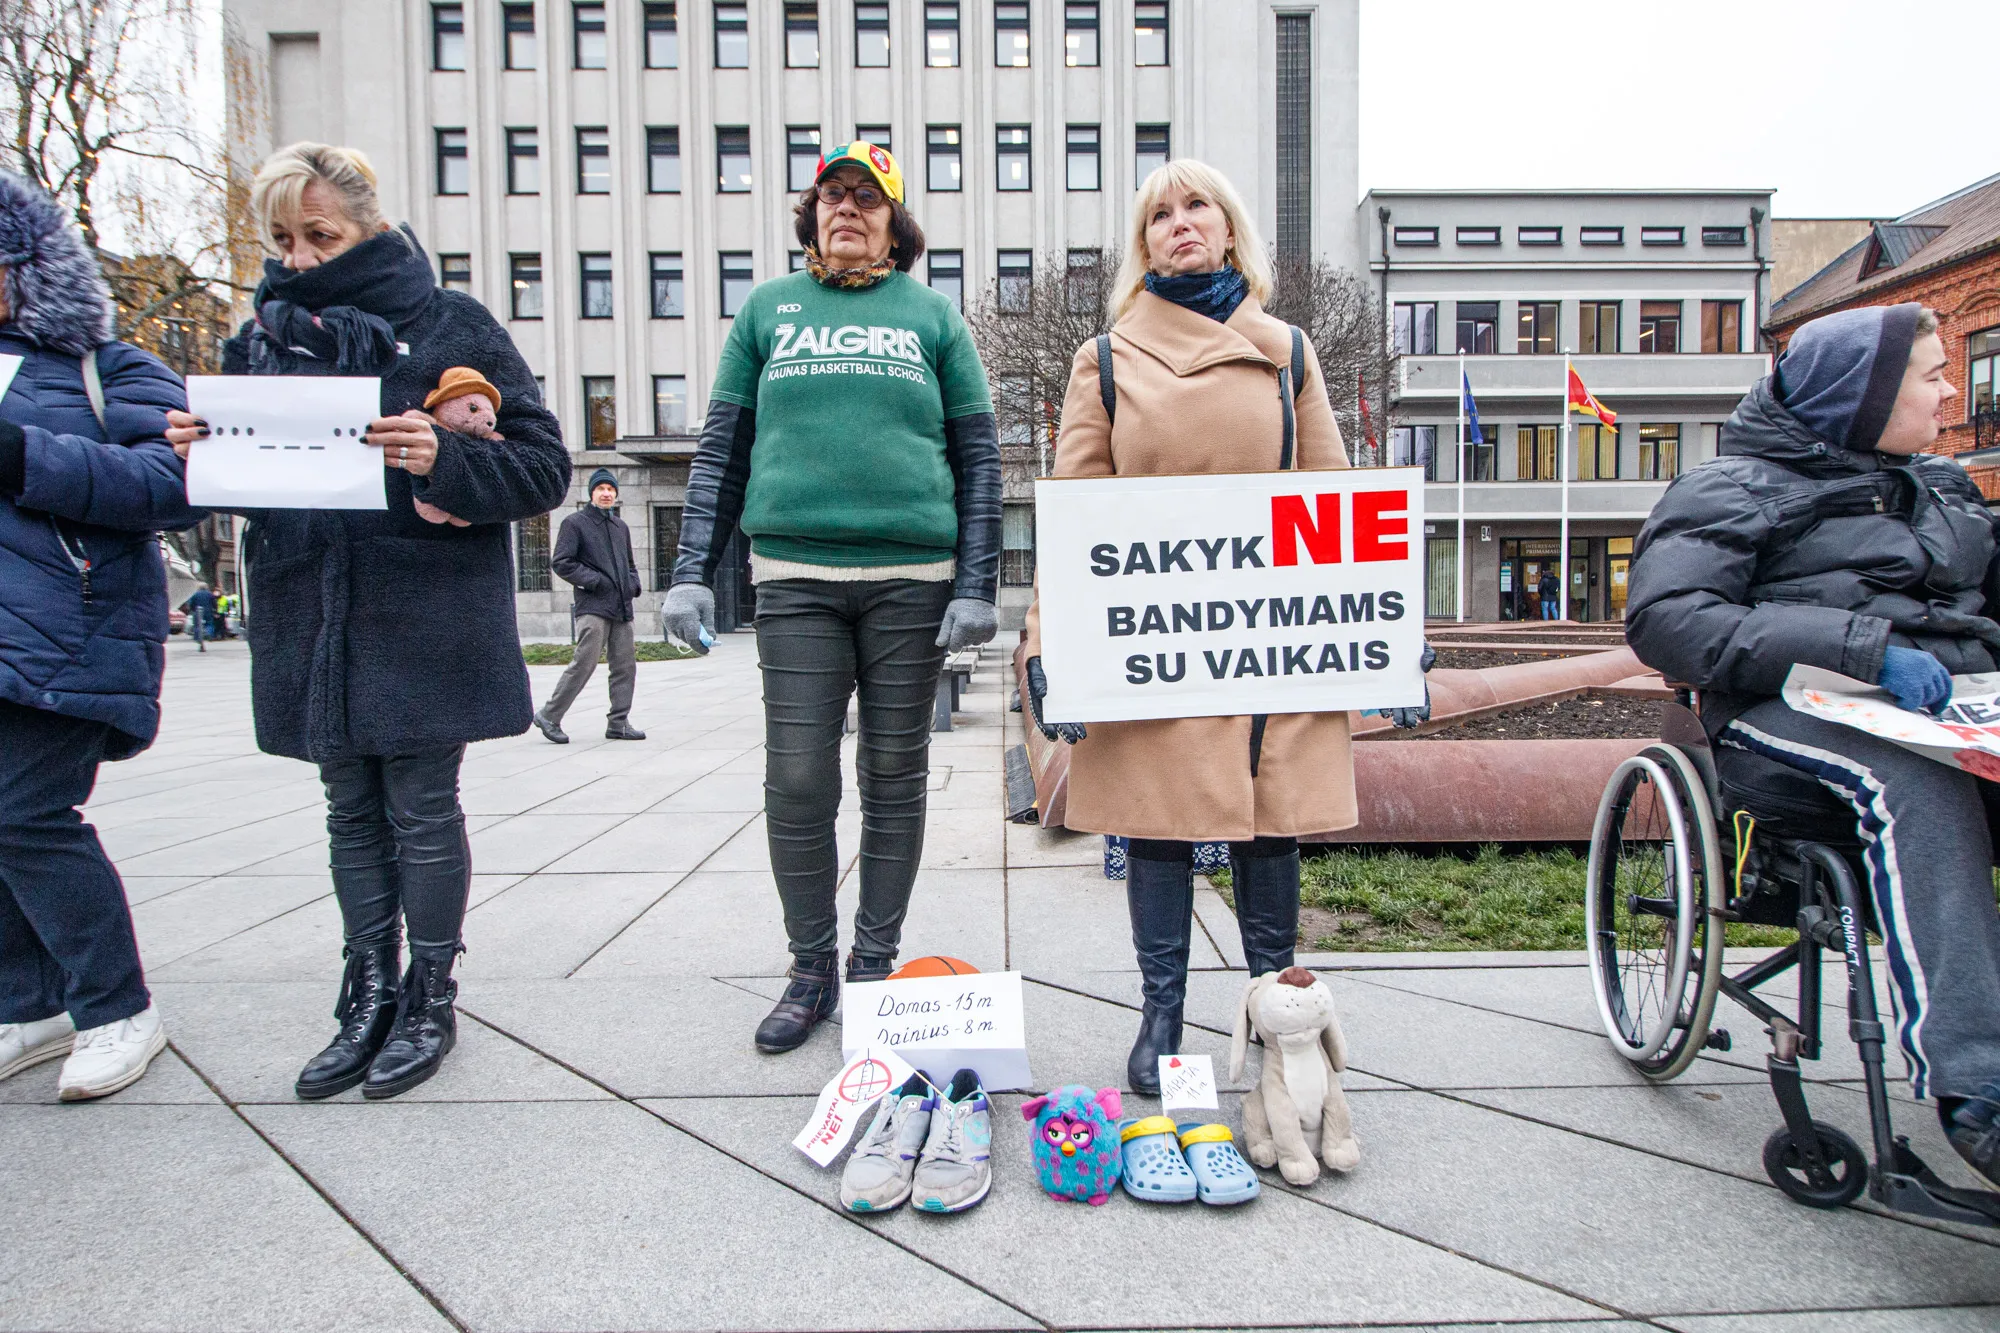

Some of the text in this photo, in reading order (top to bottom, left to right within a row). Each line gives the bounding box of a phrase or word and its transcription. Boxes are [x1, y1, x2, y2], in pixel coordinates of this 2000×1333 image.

[771, 323, 922, 363] ŽALGIRIS
[767, 362, 927, 384] KAUNAS BASKETBALL SCHOOL
[1090, 490, 1408, 577] SAKYK NE
[1107, 591, 1405, 637] BANDYMAMS
[1125, 640, 1390, 685] SU VAIKAIS
[1840, 905, 1860, 967] COMPACT
[877, 994, 941, 1017] Domas
[806, 1097, 840, 1149] PRIEVARTAI
